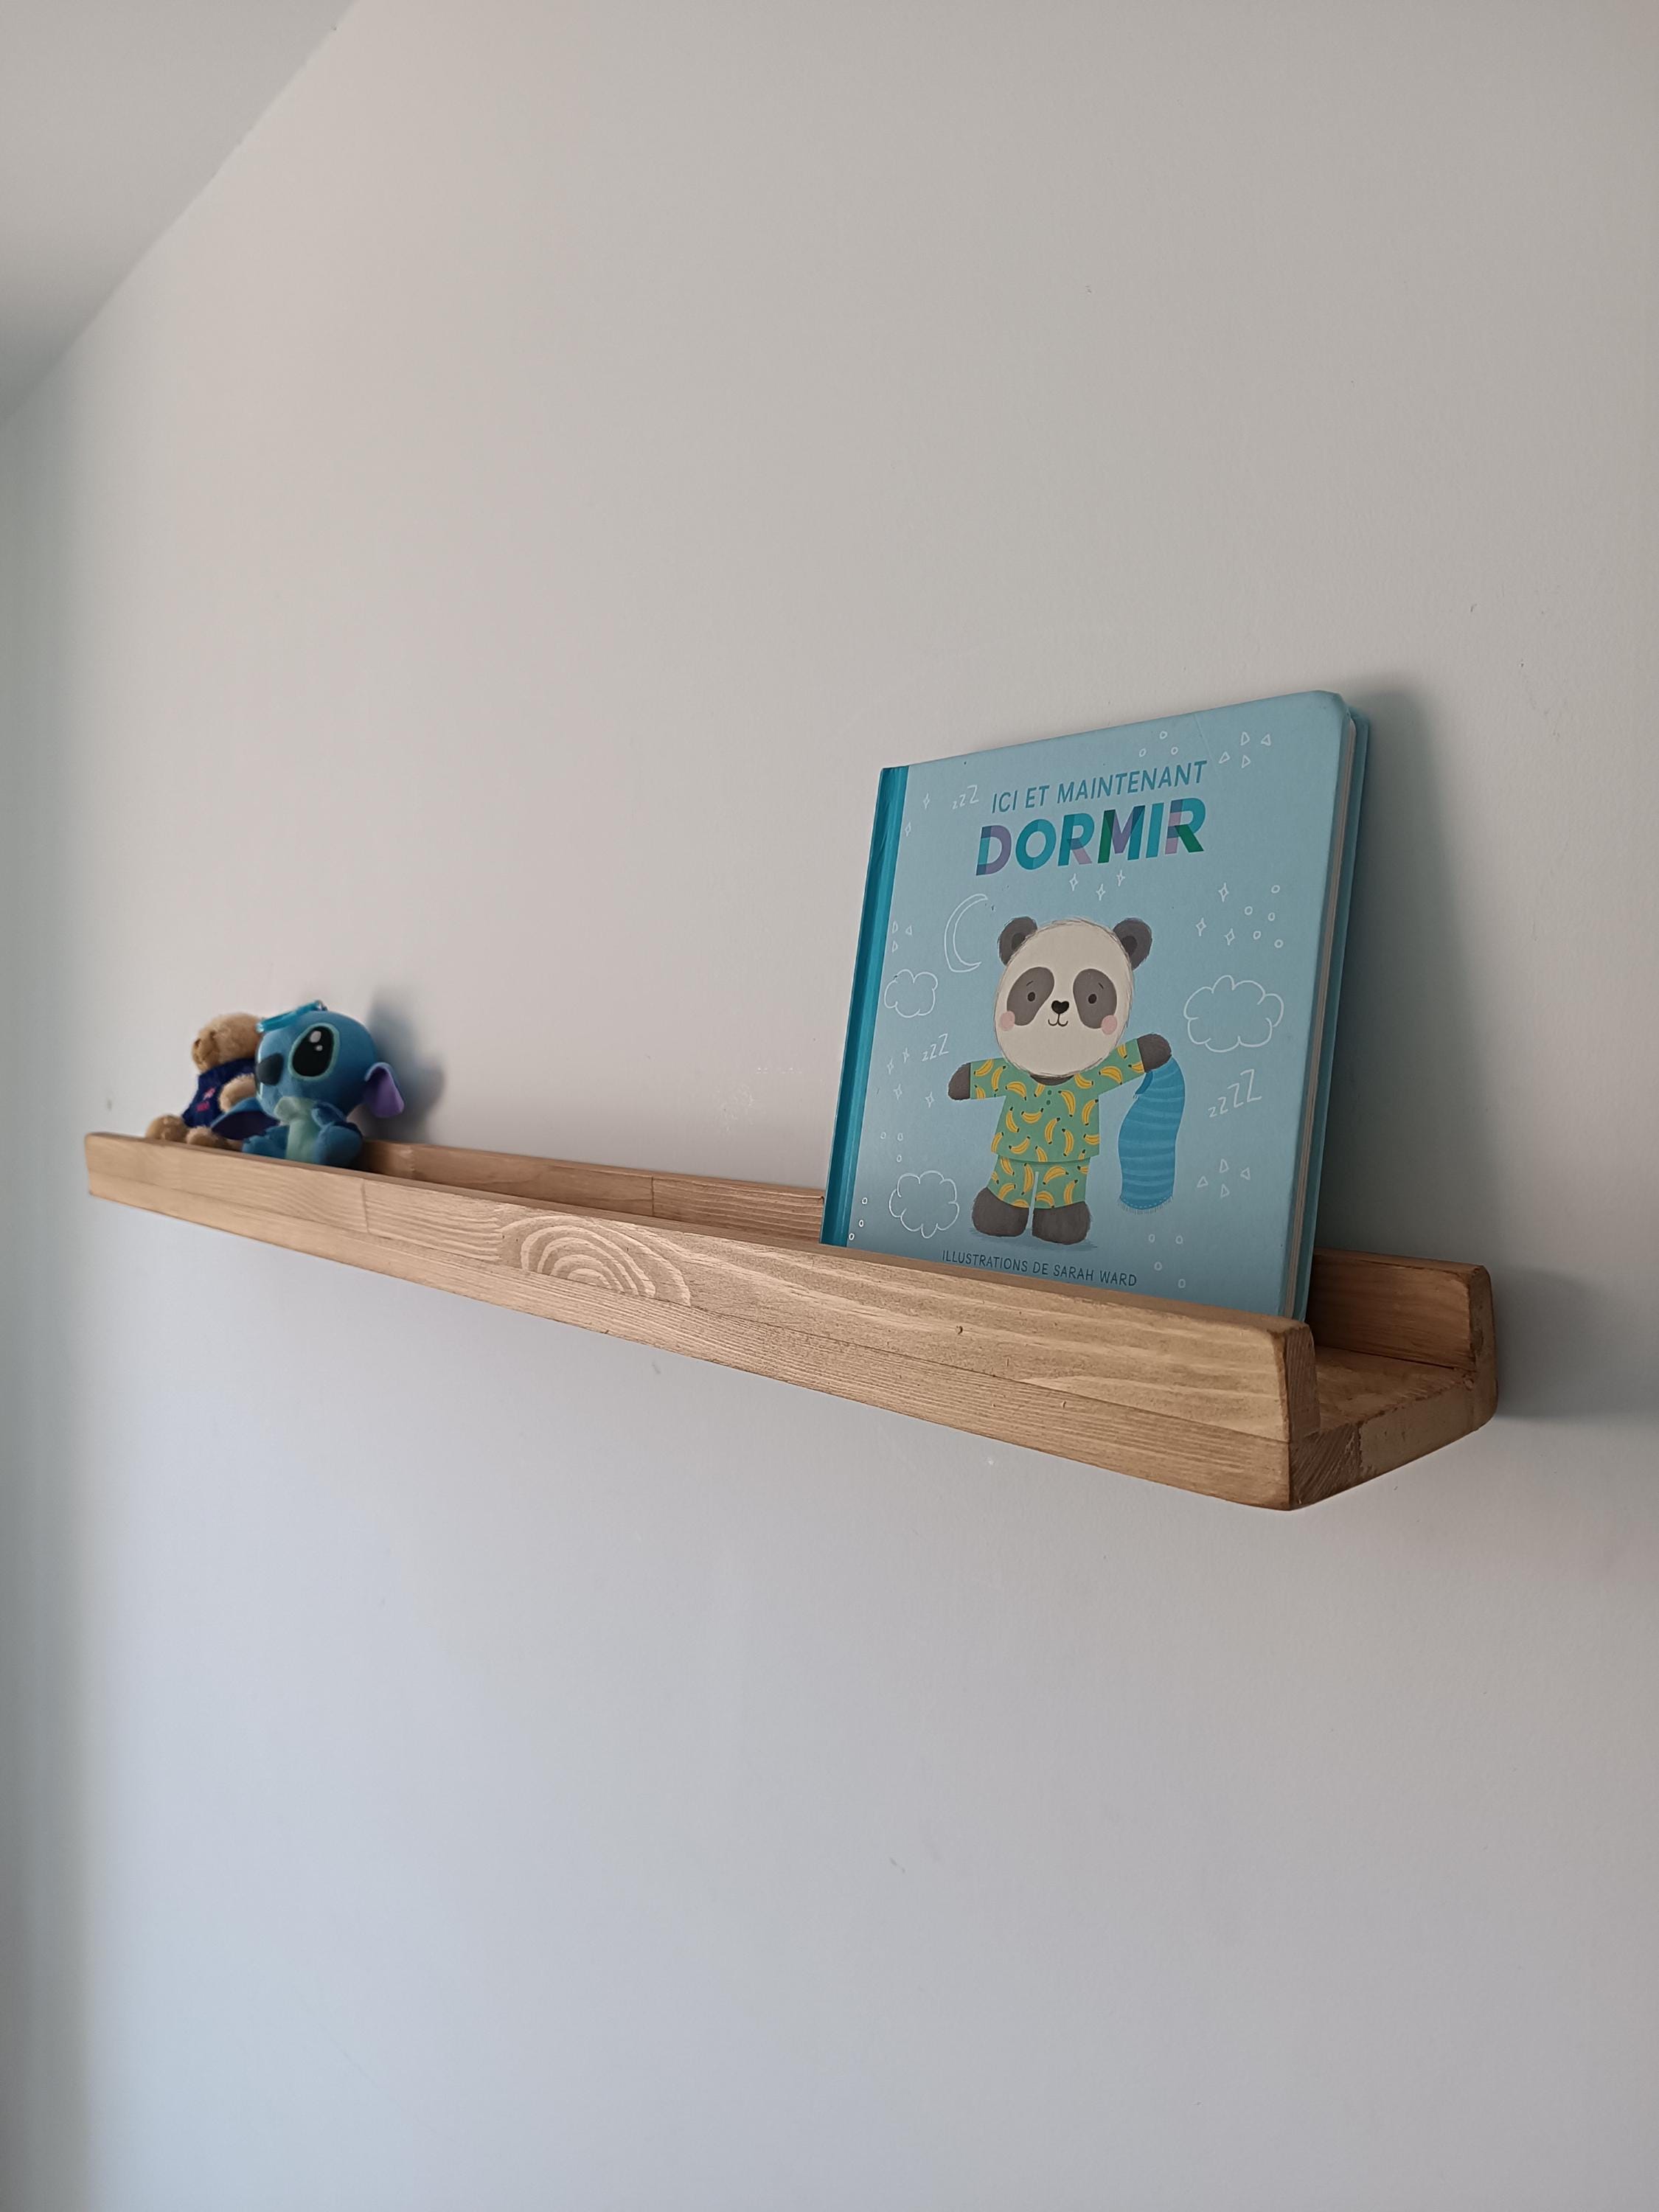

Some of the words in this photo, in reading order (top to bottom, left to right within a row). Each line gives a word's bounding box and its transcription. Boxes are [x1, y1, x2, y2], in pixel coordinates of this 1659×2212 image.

[992, 789, 1018, 813] ICI
[1025, 785, 1050, 808] ET
[1057, 760, 1208, 804] MAINTENANT
[975, 797, 1207, 876] DORMIR
[942, 1250, 1029, 1273] ILLUSTRATIONS
[1032, 1261, 1049, 1276] DE
[1053, 1265, 1094, 1281] SARAH
[1099, 1270, 1137, 1287] WARD
